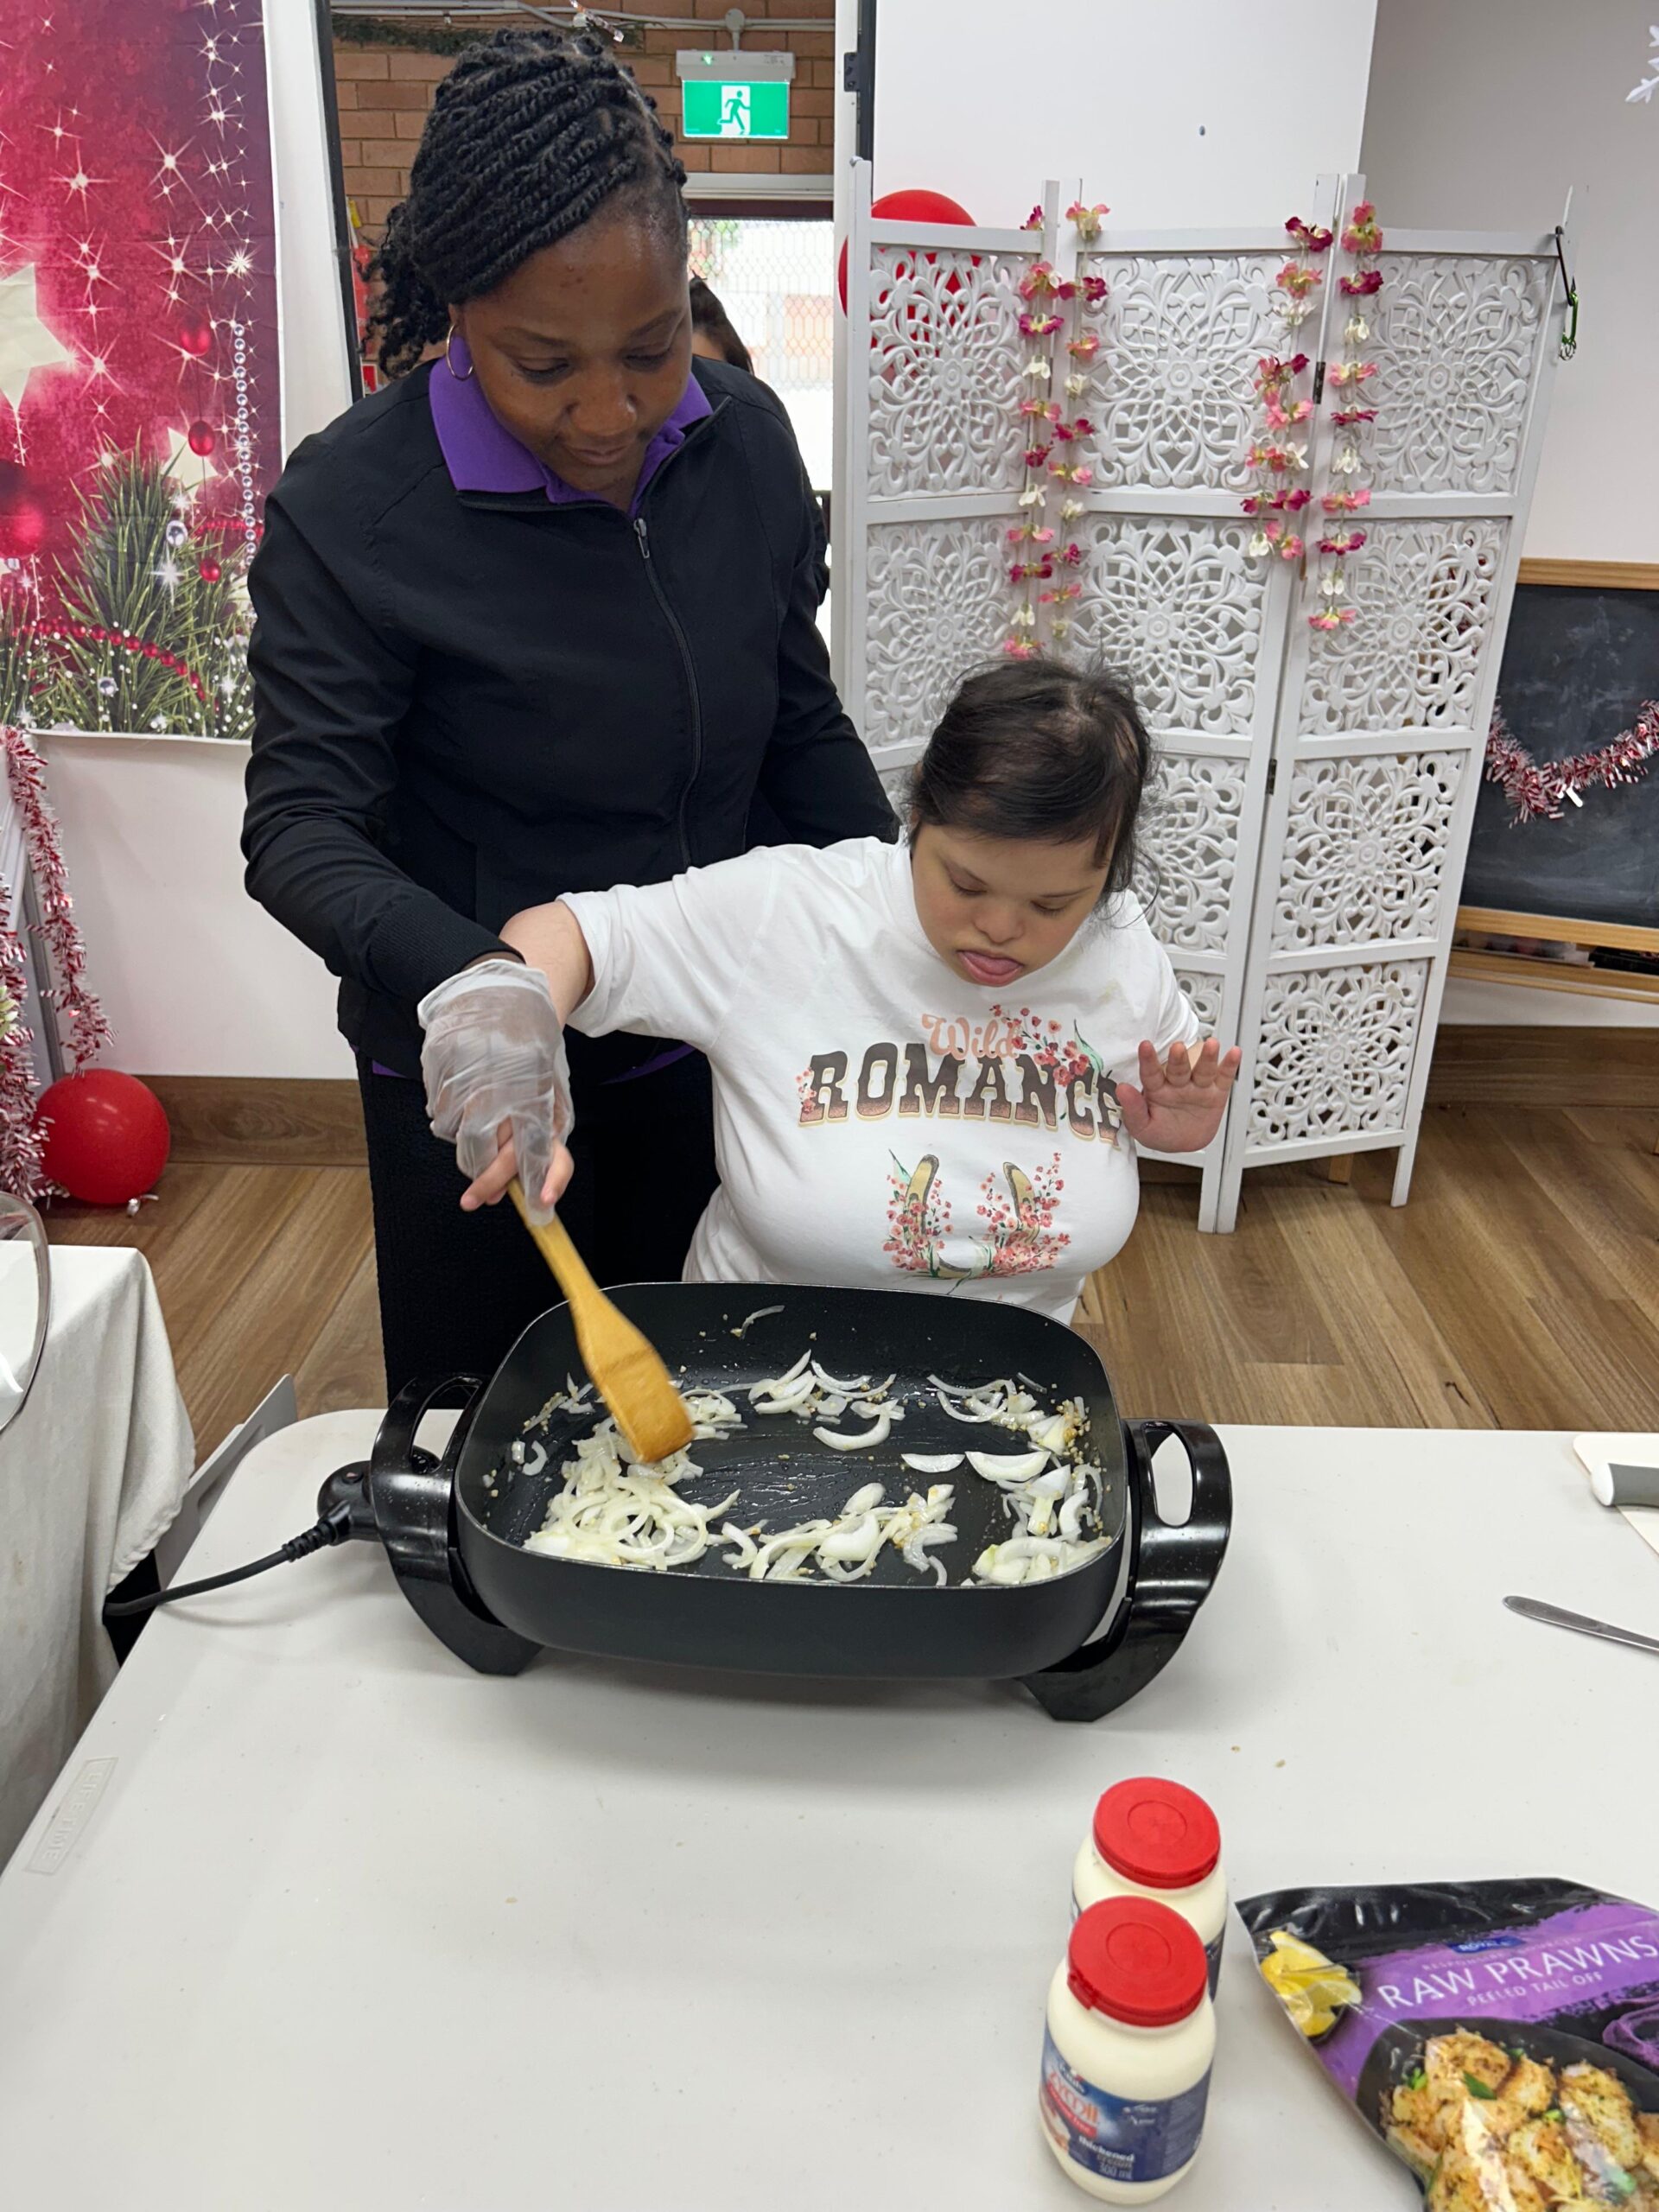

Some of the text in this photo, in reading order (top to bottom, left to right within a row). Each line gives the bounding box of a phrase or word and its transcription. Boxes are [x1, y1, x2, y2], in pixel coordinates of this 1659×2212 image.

[921, 1013, 1020, 1061] Wild
[798, 1042, 1123, 1150] ROMANCE
[1377, 1935, 1659, 2009] RAW PRAWNS
[1466, 1971, 1603, 2006] PEELED TAIL OFF
